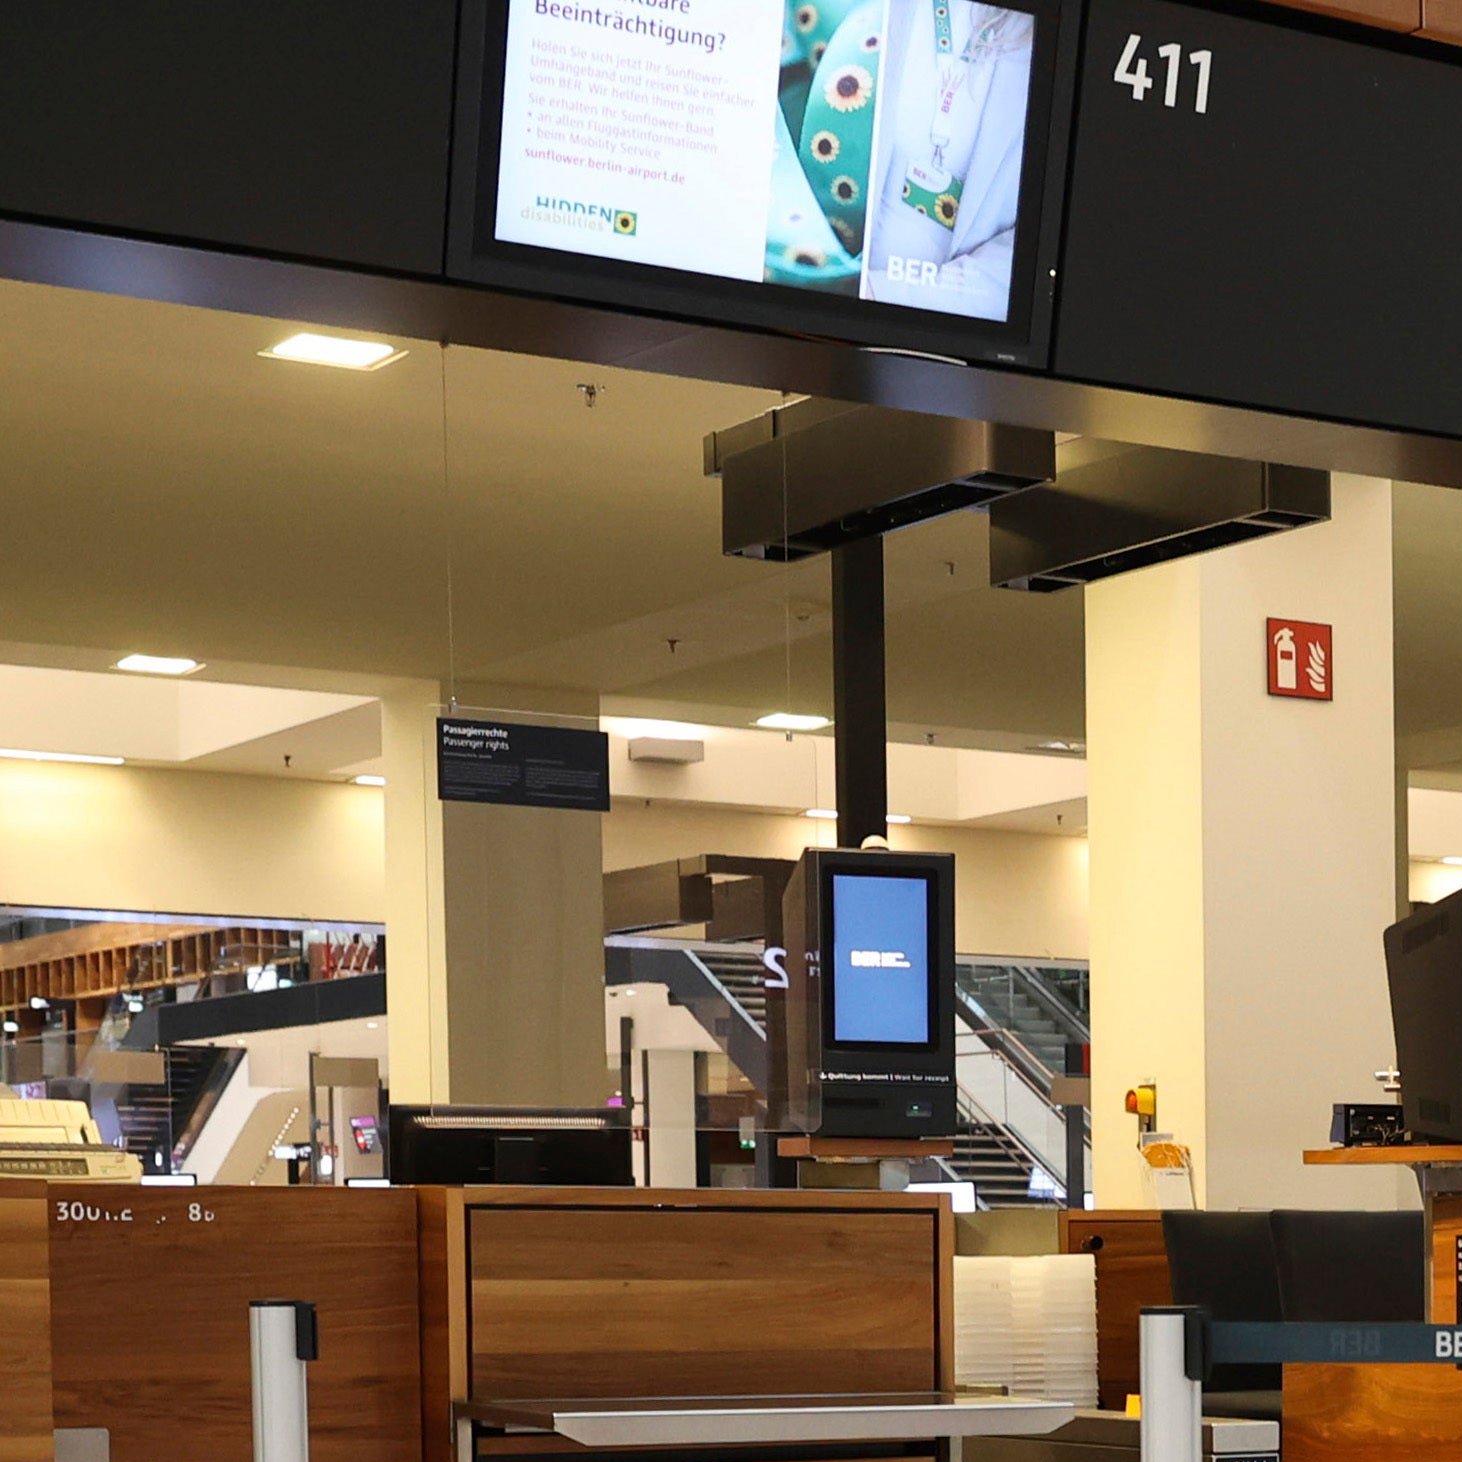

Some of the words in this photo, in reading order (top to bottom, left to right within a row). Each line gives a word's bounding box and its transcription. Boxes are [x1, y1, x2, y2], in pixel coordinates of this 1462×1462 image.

[534, 0, 727, 53] Beeinträchtigung?
[570, 46, 588, 60] Sie
[590, 49, 613, 64] sich
[529, 72, 555, 87] vom
[588, 82, 608, 97] Wir
[619, 73, 642, 87] und
[645, 79, 680, 94] reisen
[683, 83, 700, 98] Sie
[1113, 34, 1212, 114] 411
[528, 91, 546, 106] Sie
[549, 96, 598, 116] erhalten
[537, 112, 552, 123] an
[536, 127, 566, 142] beim
[569, 133, 617, 154] Mobility
[620, 142, 662, 160] Service
[887, 254, 938, 288] BER
[443, 724, 509, 739] Passagierrechte
[443, 737, 484, 750] Passenger
[486, 741, 510, 751] rights
